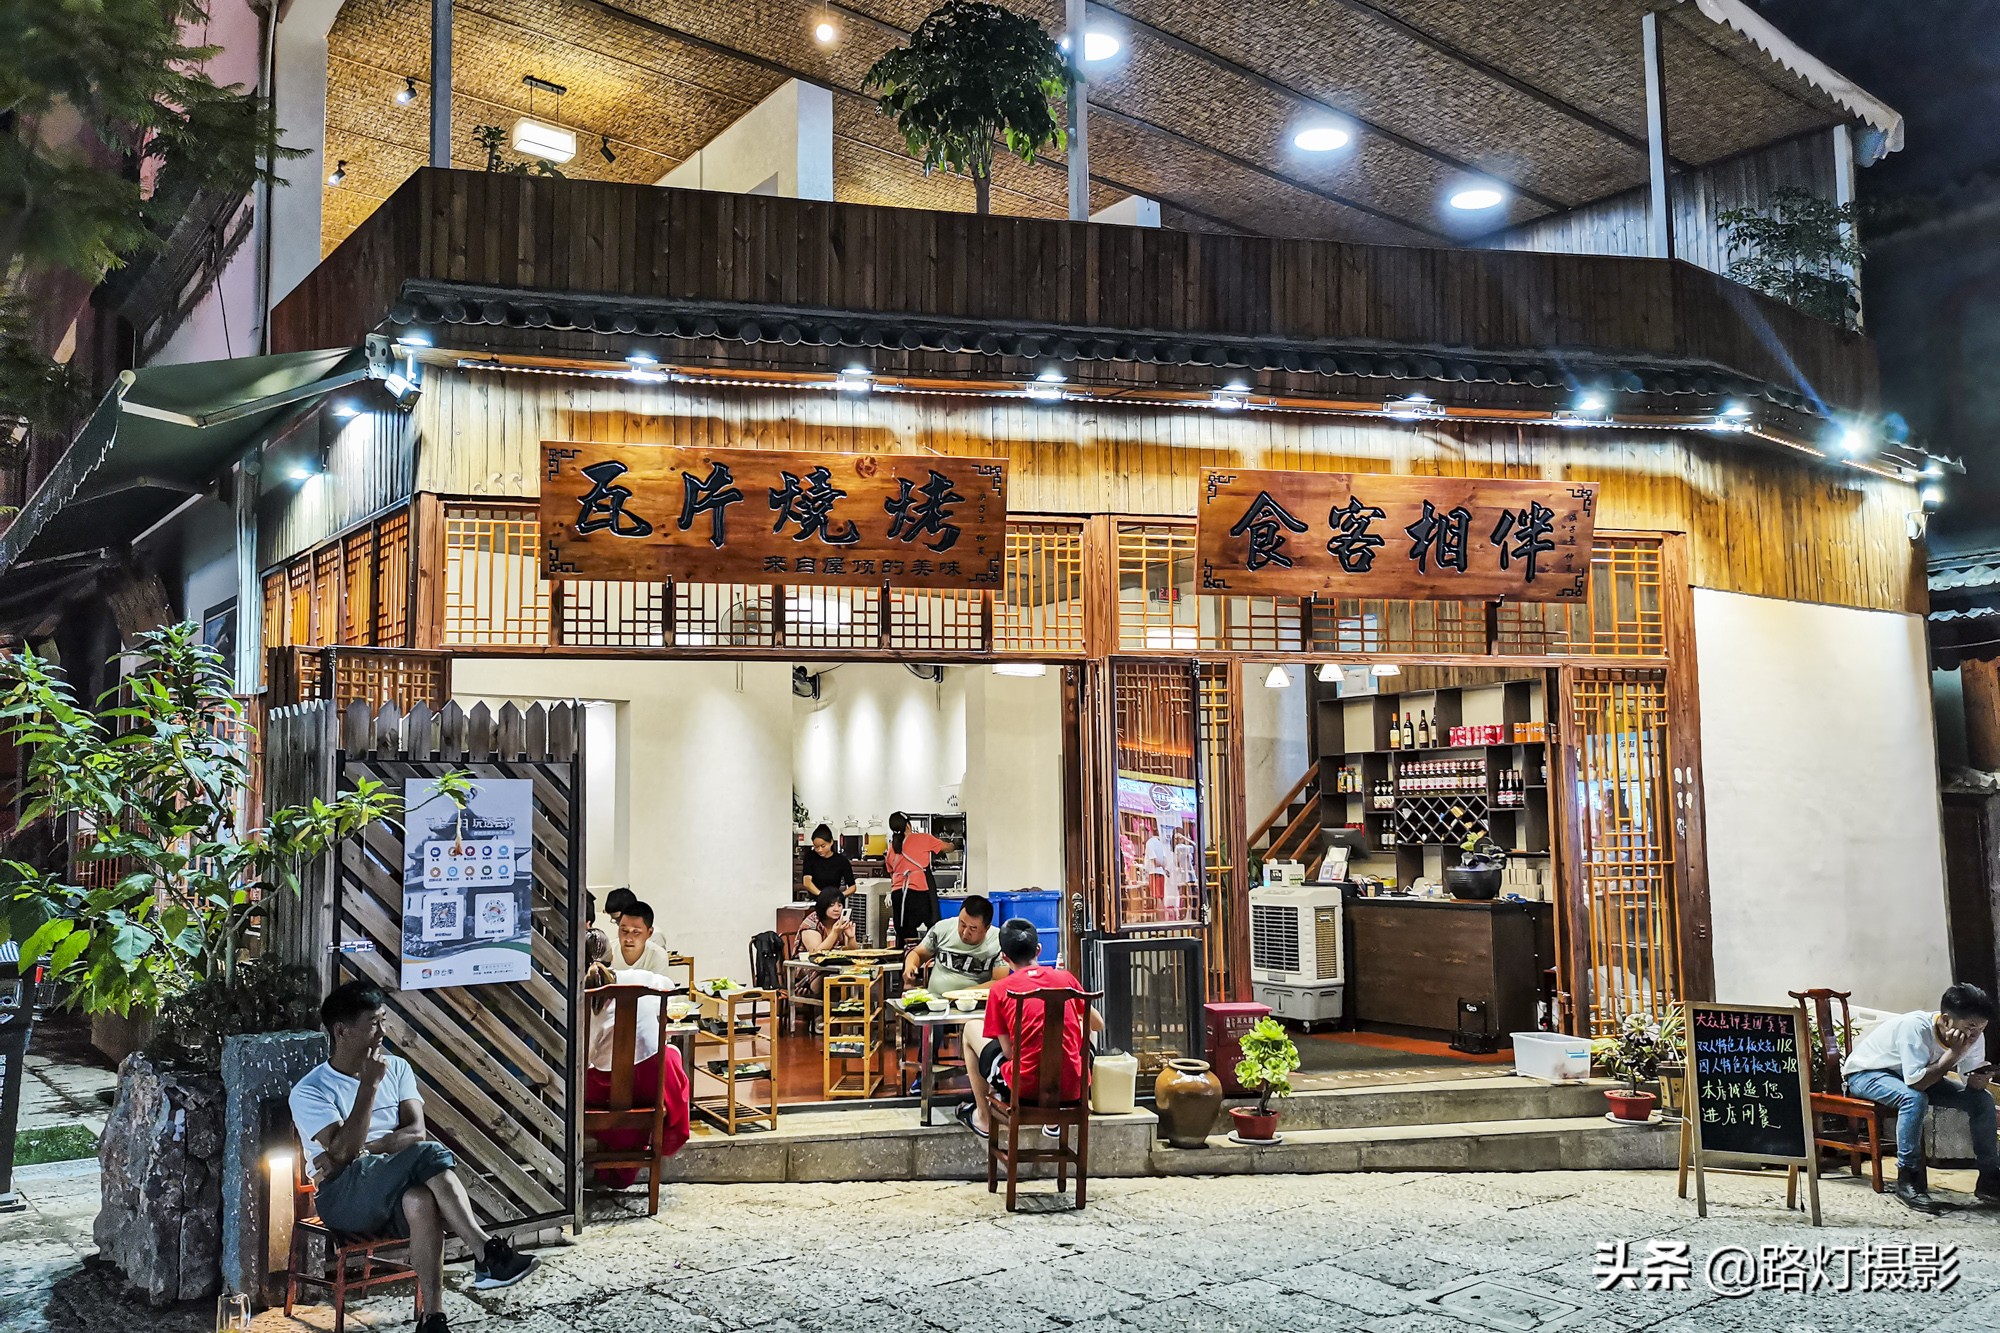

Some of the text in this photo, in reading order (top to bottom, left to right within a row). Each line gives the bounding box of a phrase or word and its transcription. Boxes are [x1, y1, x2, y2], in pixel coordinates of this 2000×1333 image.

[575, 460, 967, 554] 瓦片燒烤
[1229, 490, 1556, 583] 食客相伴
[1701, 1103, 1781, 1129] 进店用餐
